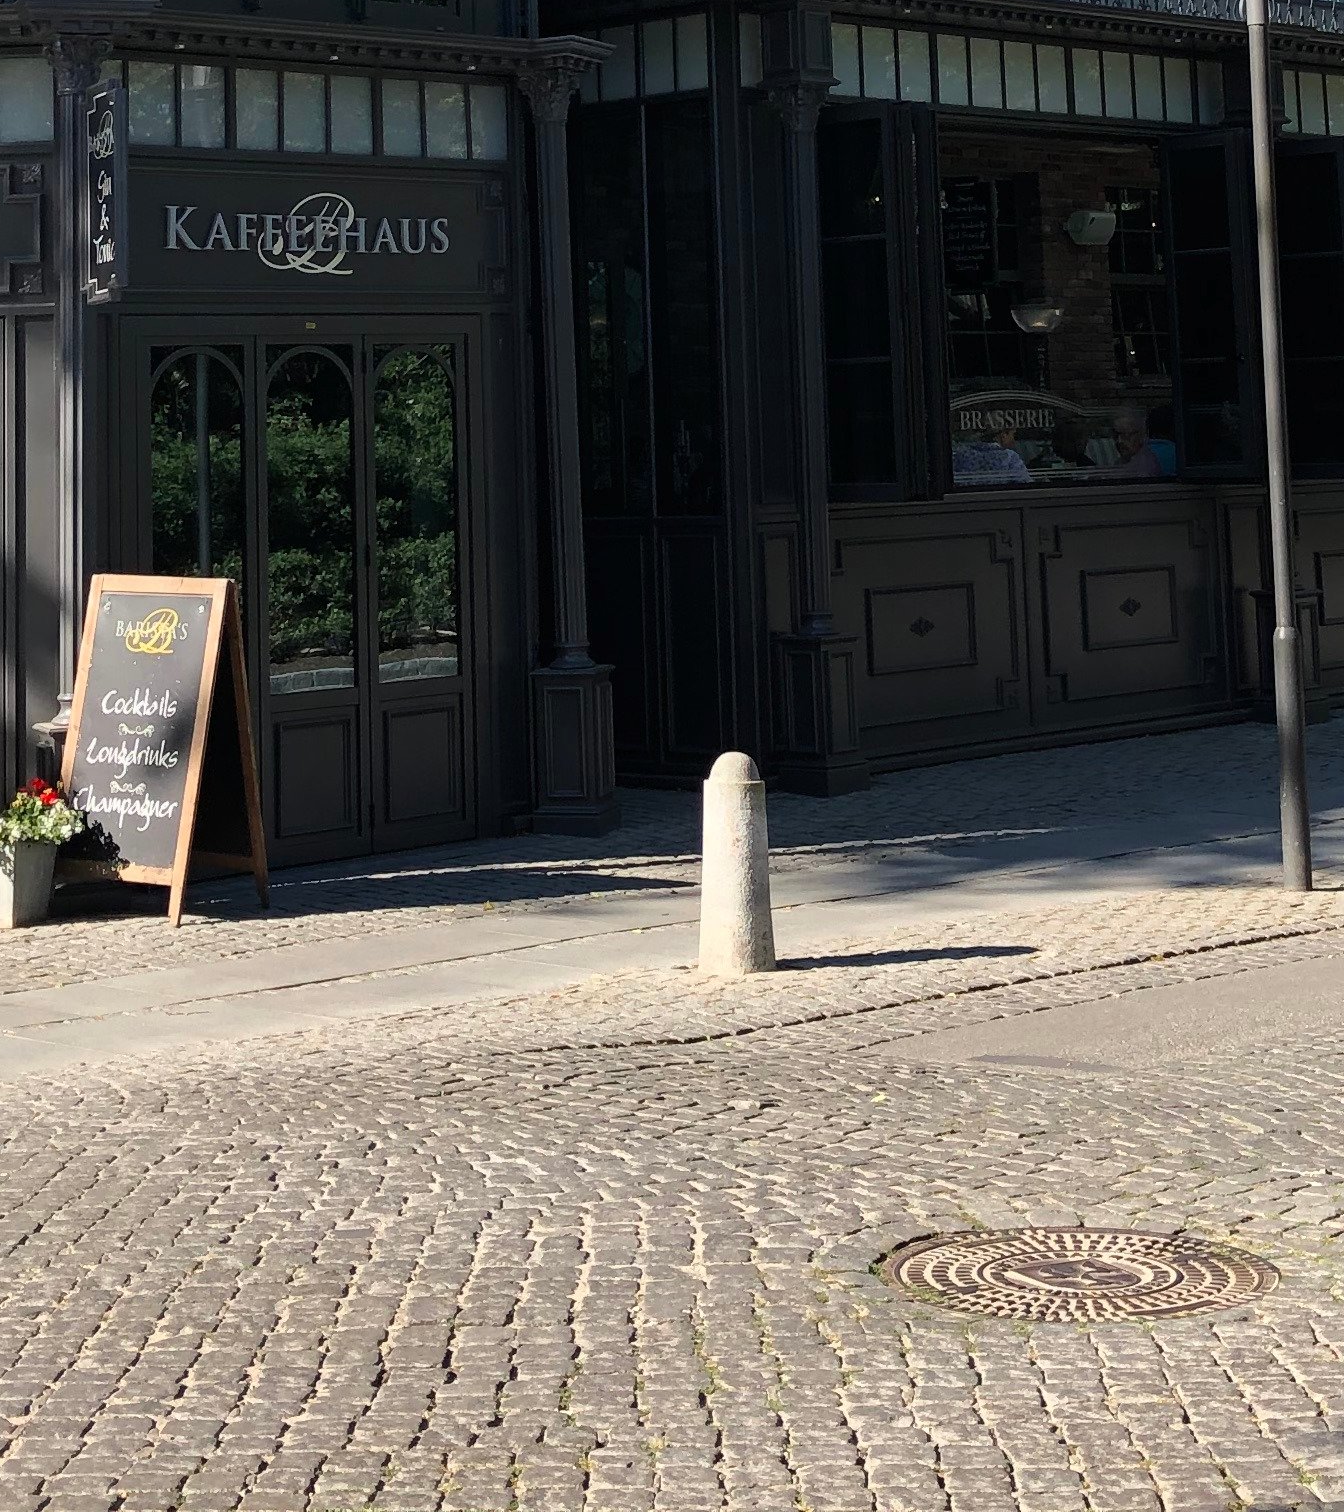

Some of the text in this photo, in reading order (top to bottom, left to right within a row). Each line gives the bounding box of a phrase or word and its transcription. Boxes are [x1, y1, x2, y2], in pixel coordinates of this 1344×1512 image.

[164, 204, 451, 255] KAFFEEHAUS
[960, 408, 1055, 431] BRASSERIE
[86, 736, 179, 779] Longdrinks
[72, 784, 179, 832] Champagner
